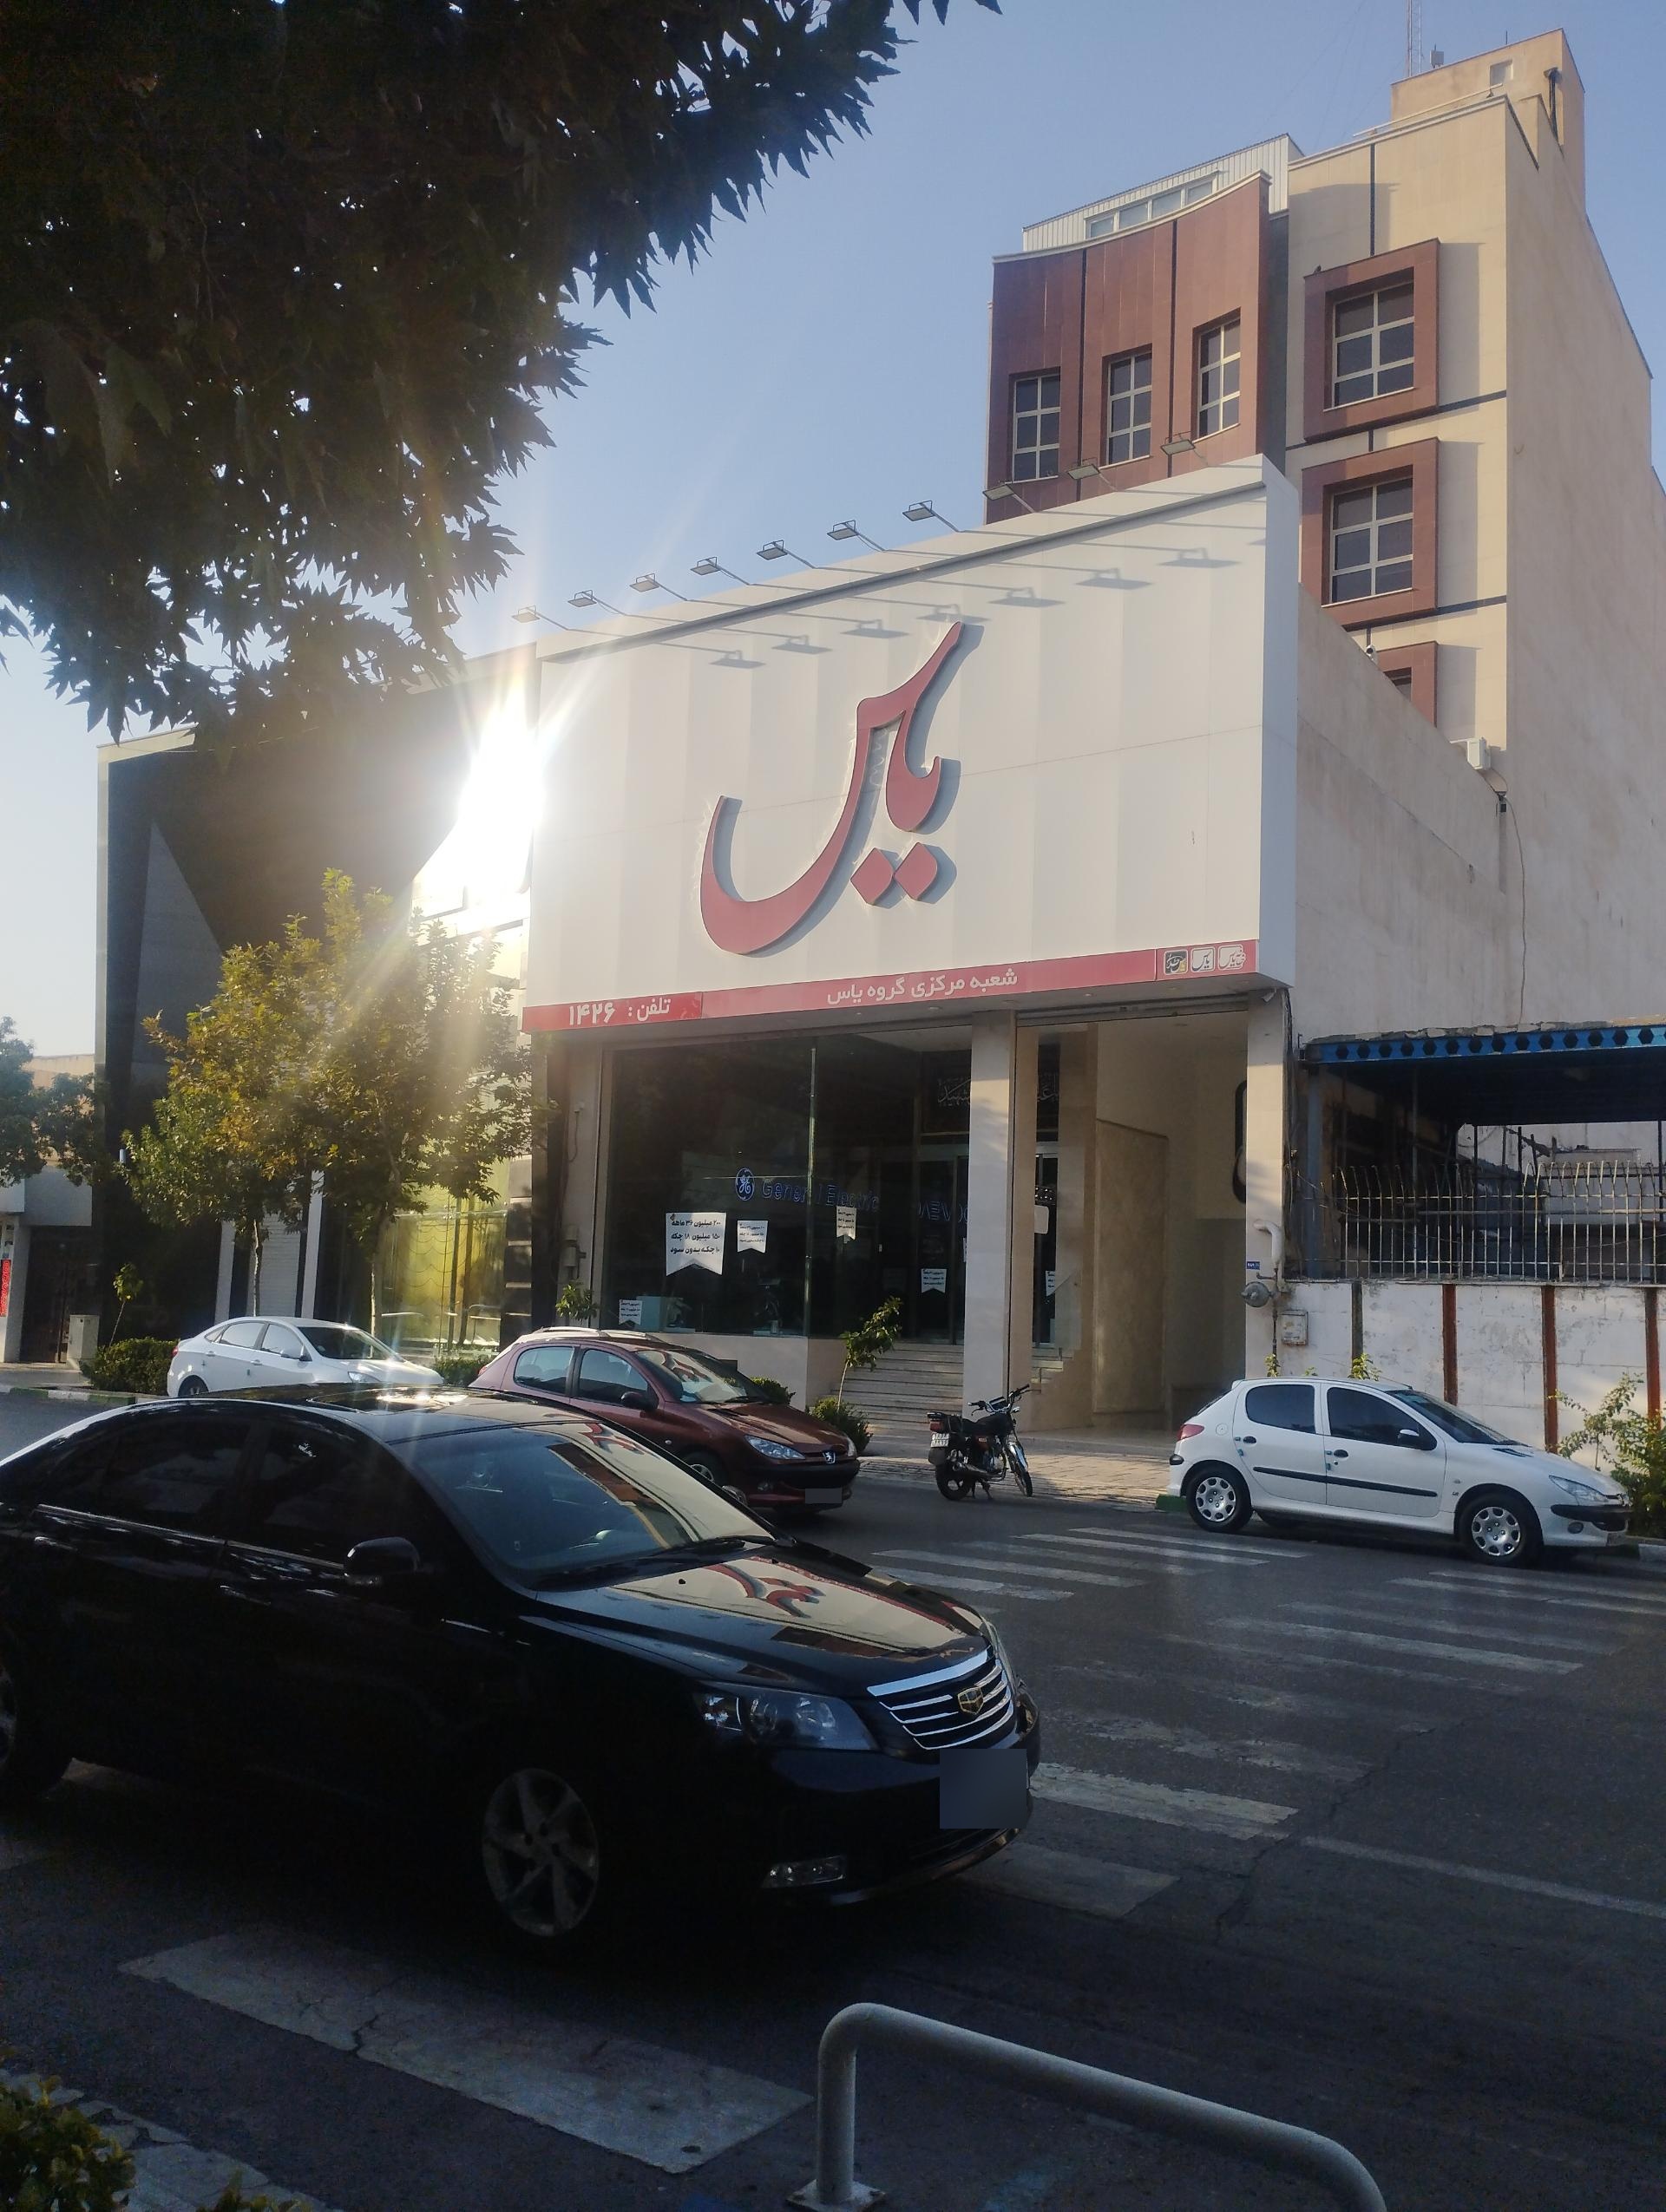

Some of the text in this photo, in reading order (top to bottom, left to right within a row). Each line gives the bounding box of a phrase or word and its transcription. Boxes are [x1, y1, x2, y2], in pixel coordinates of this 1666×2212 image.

[700, 621, 963, 955] یاس
[827, 967, 1018, 1005] شعبه مرکزی گروه یاس
[569, 1002, 616, 1026] ۱۴۲۶
[762, 1179, 822, 1205] Generl
[693, 1219, 712, 1227] میلیون
[692, 1233, 711, 1241] میلیون
